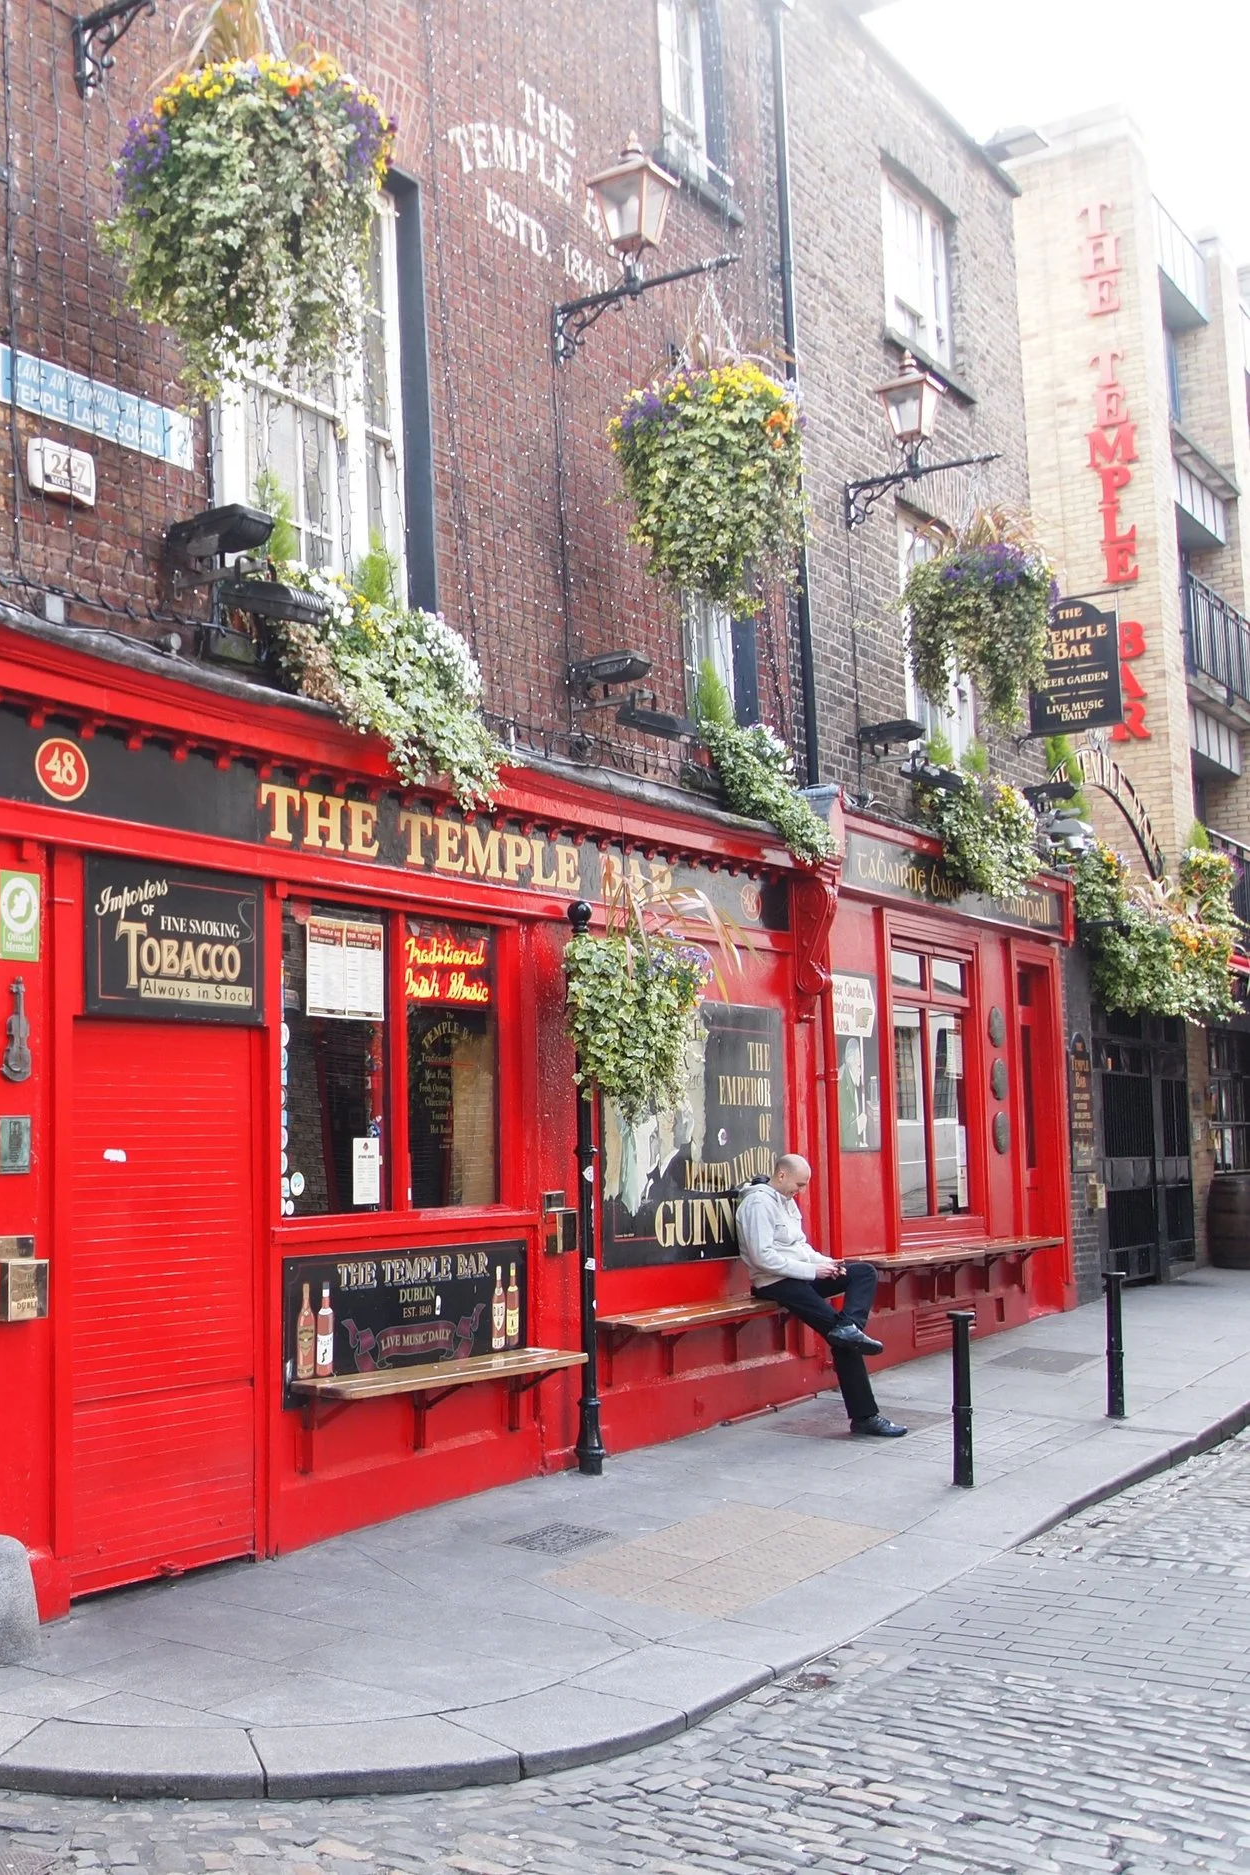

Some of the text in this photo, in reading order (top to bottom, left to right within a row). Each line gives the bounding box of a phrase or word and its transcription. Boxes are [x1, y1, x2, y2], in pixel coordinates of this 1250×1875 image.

[518, 80, 576, 157] THE
[447, 122, 573, 204] TEMPLE
[49, 371, 67, 390] AN
[16, 383, 162, 451] TEMPLE LANE SOUTH
[176, 429, 188, 452] 2
[1077, 200, 1151, 742] THE TEMPLE BAR
[1057, 607, 1083, 620] THE
[1052, 642, 1092, 661] BAR
[1067, 671, 1109, 685] GARDEN
[1046, 699, 1104, 715] LIVE MUSIC
[1061, 710, 1090, 722] DAILY
[44, 747, 77, 786] 48
[259, 783, 380, 858] THE
[400, 811, 582, 892] TEMPLE
[95, 878, 169, 920] Importers
[141, 904, 155, 917] OF
[160, 915, 240, 939] FINE SMOKING
[115, 920, 241, 989] TOBACCO
[405, 937, 485, 965] Traditional
[143, 978, 251, 1003] Always in Stock
[422, 1020, 460, 1050] TEMPLE
[747, 1042, 771, 1071] THE
[719, 1076, 772, 1107] EMPEROR
[758, 1113, 772, 1142] OF
[684, 1160, 731, 1193] MALTED
[655, 1198, 737, 1248] GUINN
[337, 1252, 490, 1289] THE TEMPLE BAR
[398, 1286, 436, 1304] DUBLIN
[403, 1305, 432, 1318] EST. 1840
[381, 1328, 452, 1351] LIVE MUSIC DAILY
